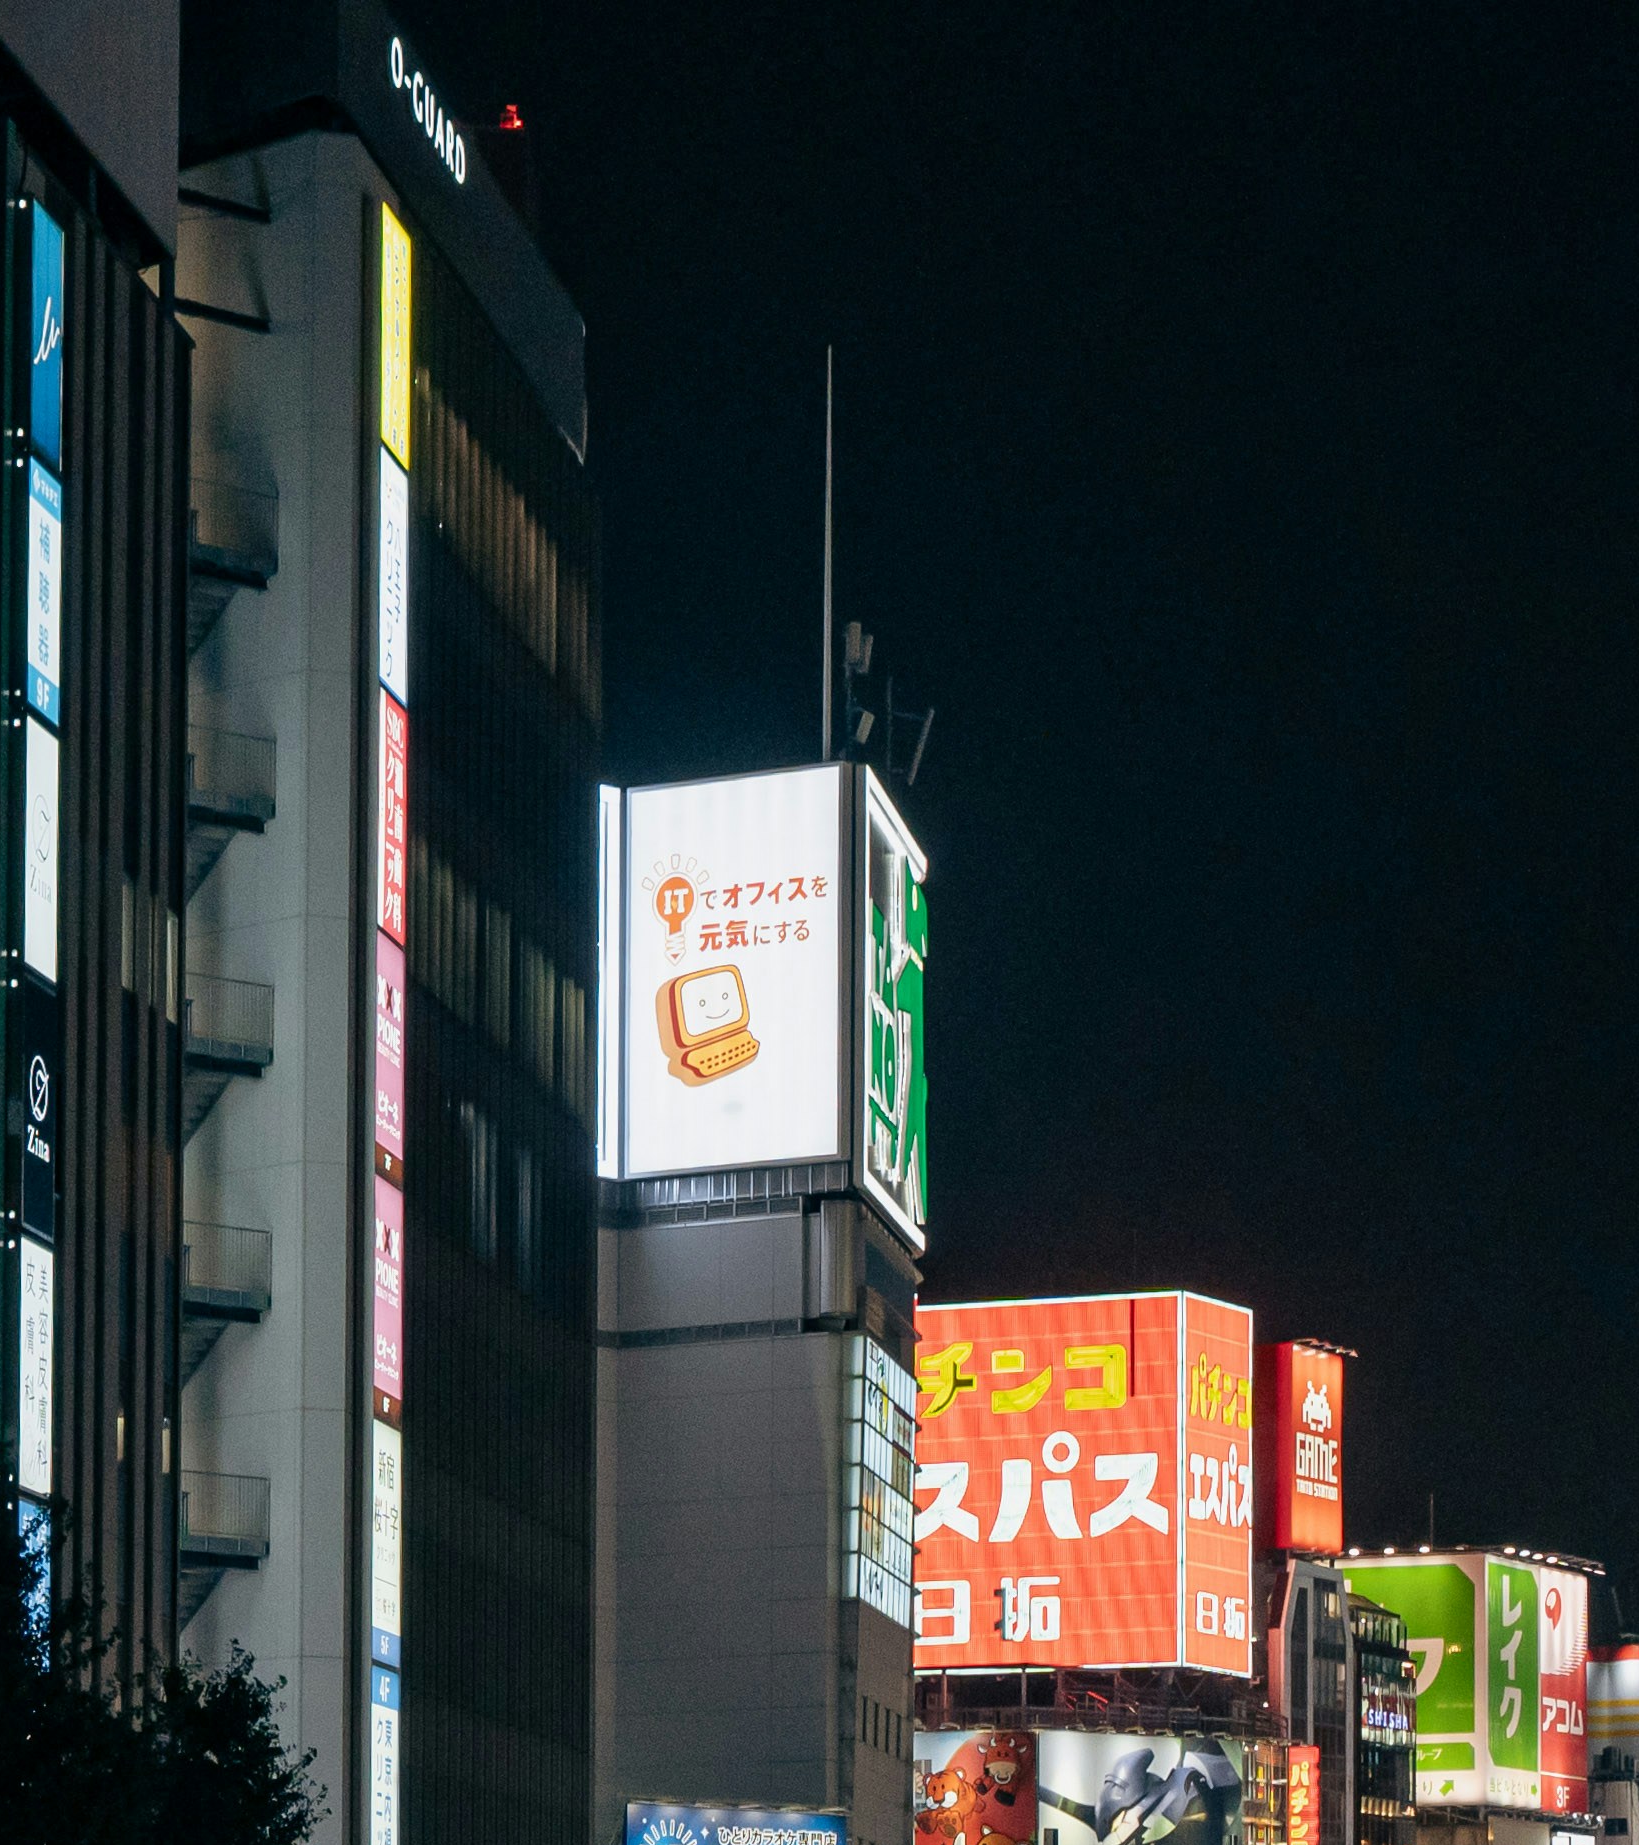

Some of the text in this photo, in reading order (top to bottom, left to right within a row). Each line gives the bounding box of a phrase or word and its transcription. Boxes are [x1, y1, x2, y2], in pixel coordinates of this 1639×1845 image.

[390, 36, 465, 184] O-GUARD
[698, 918, 812, 953] 元気にする
[27, 1123, 50, 1163] Zina
[1190, 1352, 1251, 1430] パチンコ
[1295, 1431, 1338, 1484] GAME
[1189, 1442, 1252, 1530] エスパス
[914, 1576, 1061, 1647] 日拓
[1195, 1590, 1246, 1642] 日拓
[1499, 1573, 1542, 1739] レイク
[1367, 1709, 1409, 1731] SHISHA
[1541, 1696, 1584, 1736] アコム
